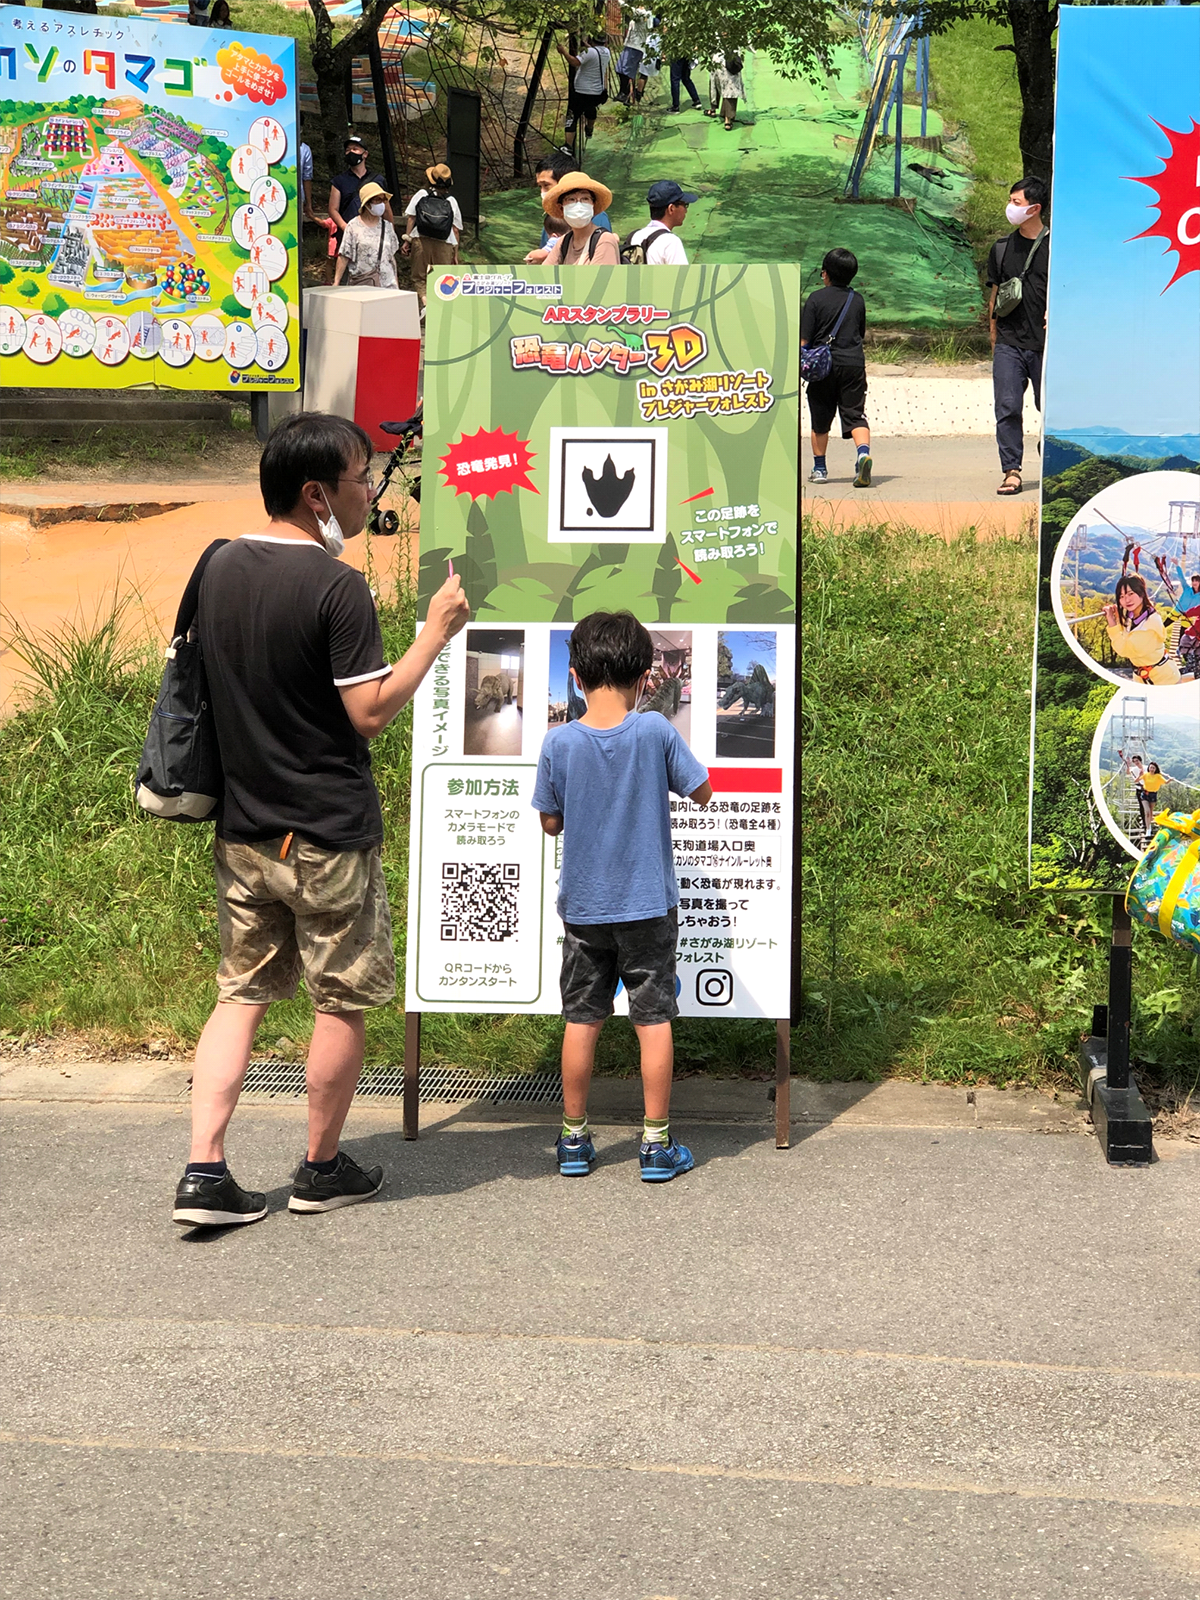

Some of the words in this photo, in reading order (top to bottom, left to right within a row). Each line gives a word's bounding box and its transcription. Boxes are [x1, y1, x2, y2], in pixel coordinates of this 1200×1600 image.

[12, 18, 124, 41] 考えるアスレチック
[230, 49, 280, 82] アタマとカラダを
[462, 282, 561, 294] プレジャーフォレスト
[544, 306, 670, 323] ARスタンプラリー
[512, 326, 702, 372] 恐竜ハンター3D
[640, 382, 656, 398] in
[662, 371, 769, 396] さがみ湖リゾート
[642, 391, 770, 417] プレジャーフォレスト
[456, 453, 518, 476] 恐竜発見!
[695, 504, 760, 523] この足跡を
[681, 521, 778, 544] スマートフォンで
[694, 541, 765, 562] 読み取ろう!
[447, 778, 519, 796] 参加方法
[444, 809, 520, 820] スマートフォンの
[447, 822, 516, 833] カメラモードで
[456, 835, 506, 846] 読み取ろう
[672, 840, 756, 852] 天狗道場入口奥
[676, 878, 780, 890] 動く恐竜が現れます。
[444, 962, 512, 974] QRコードから
[438, 976, 518, 987] カンタンスタート
